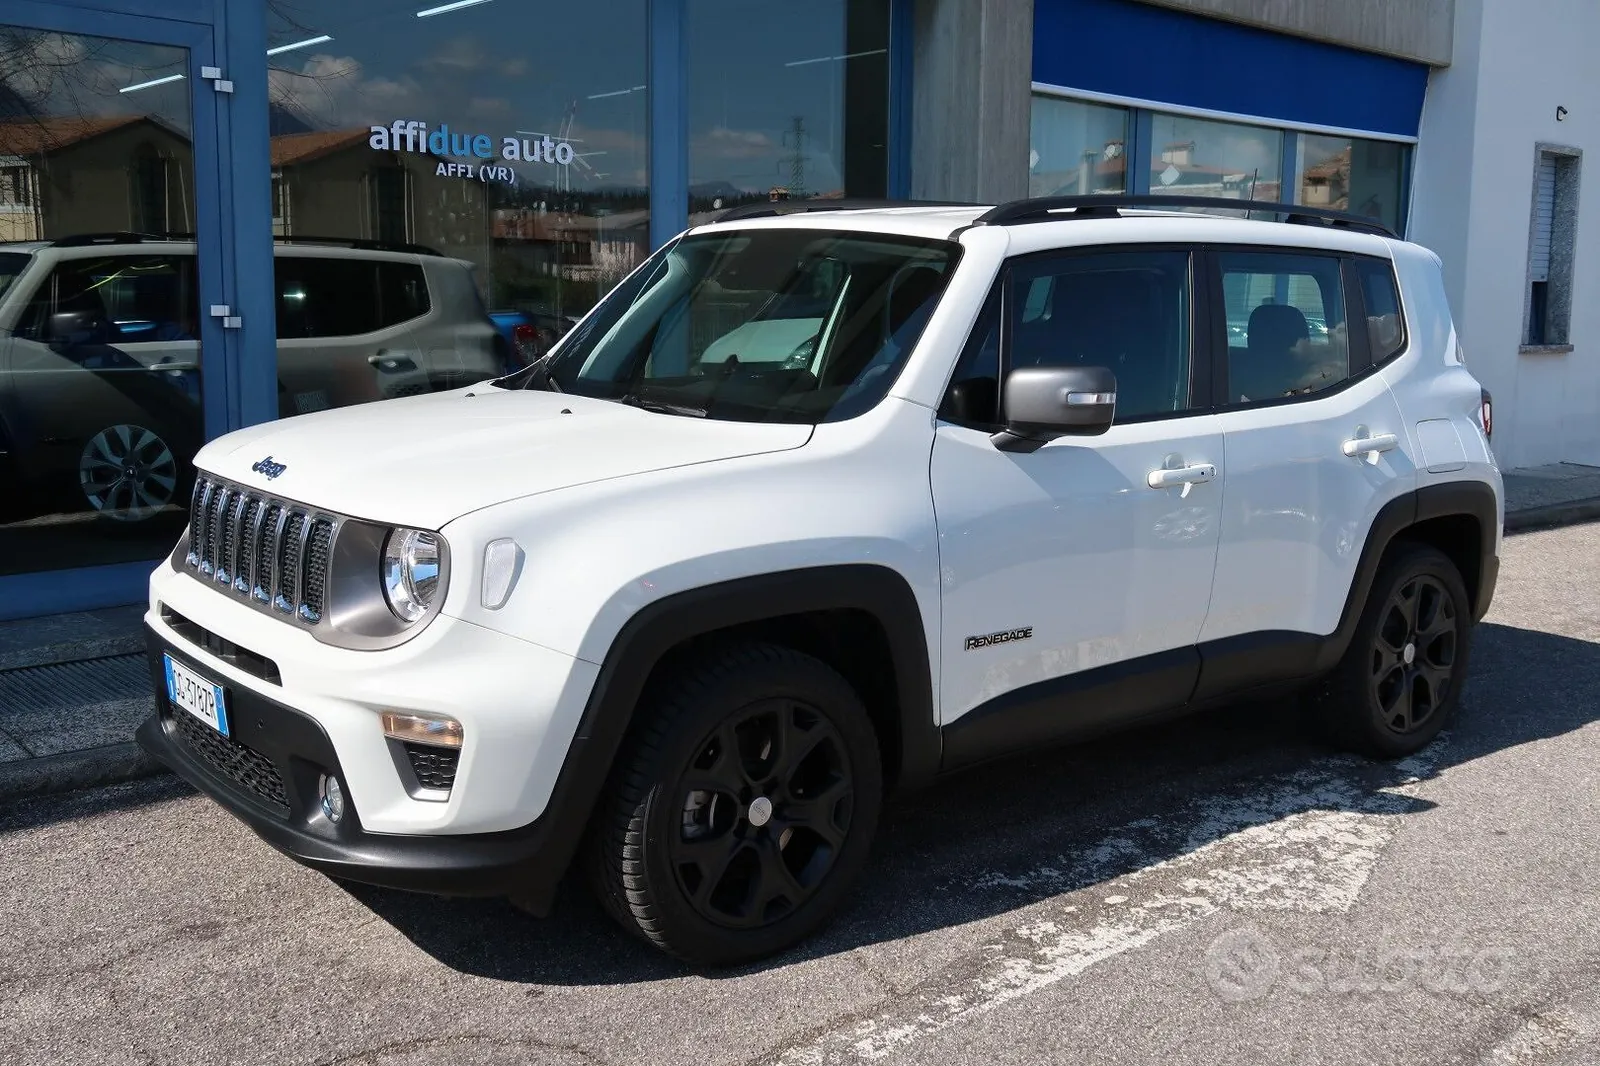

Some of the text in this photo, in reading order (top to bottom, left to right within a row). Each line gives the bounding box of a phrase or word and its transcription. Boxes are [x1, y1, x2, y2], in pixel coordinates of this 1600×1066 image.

[368, 119, 574, 165] affidue auto
[435, 162, 515, 184] AFFI (VR)
[251, 455, 287, 481] Jeep
[964, 625, 1033, 651] RENEGADE
